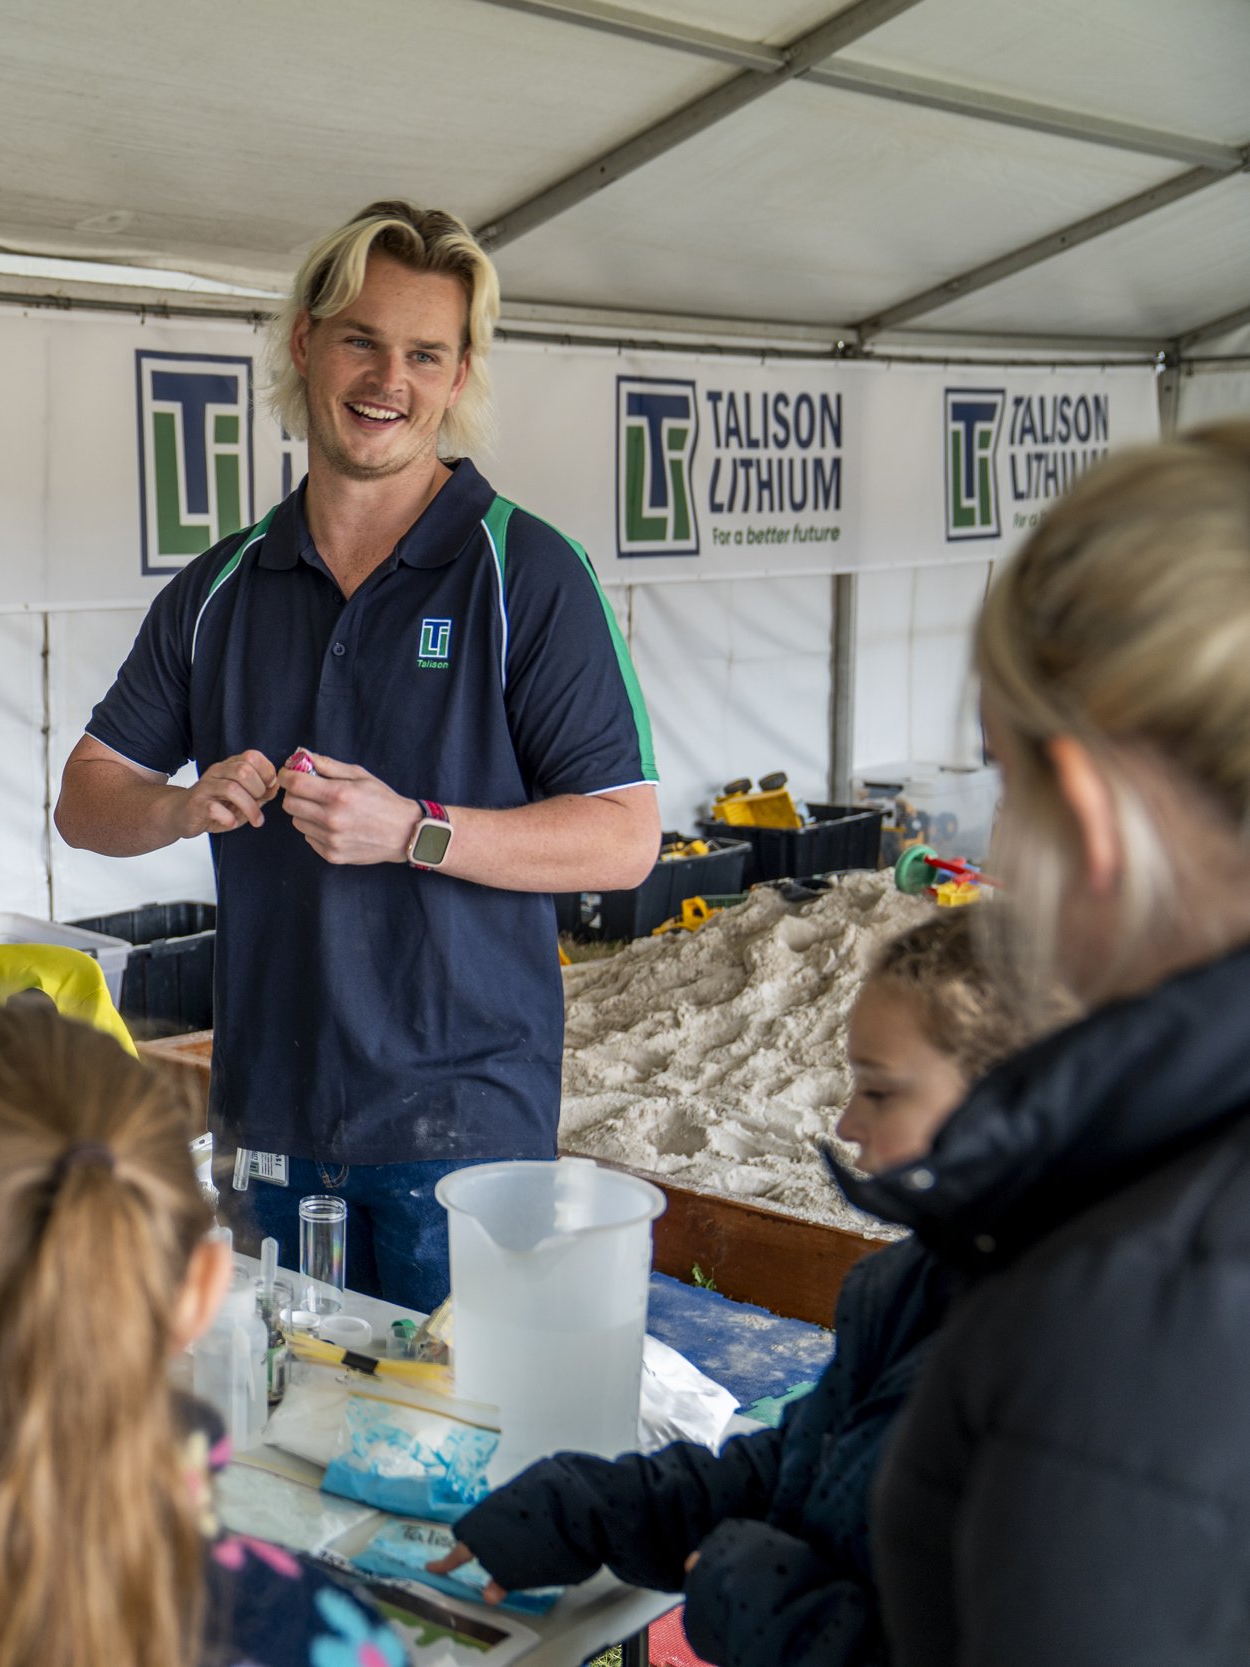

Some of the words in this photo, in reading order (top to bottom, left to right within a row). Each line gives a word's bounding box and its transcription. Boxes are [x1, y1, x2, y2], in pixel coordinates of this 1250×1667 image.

[706, 390, 843, 450] TALISON
[1009, 393, 1108, 446] TALISON
[708, 456, 843, 514] LITHIUM
[734, 529, 743, 545] a
[746, 525, 791, 545] better
[793, 522, 841, 544] future
[416, 659, 449, 669] Talison
